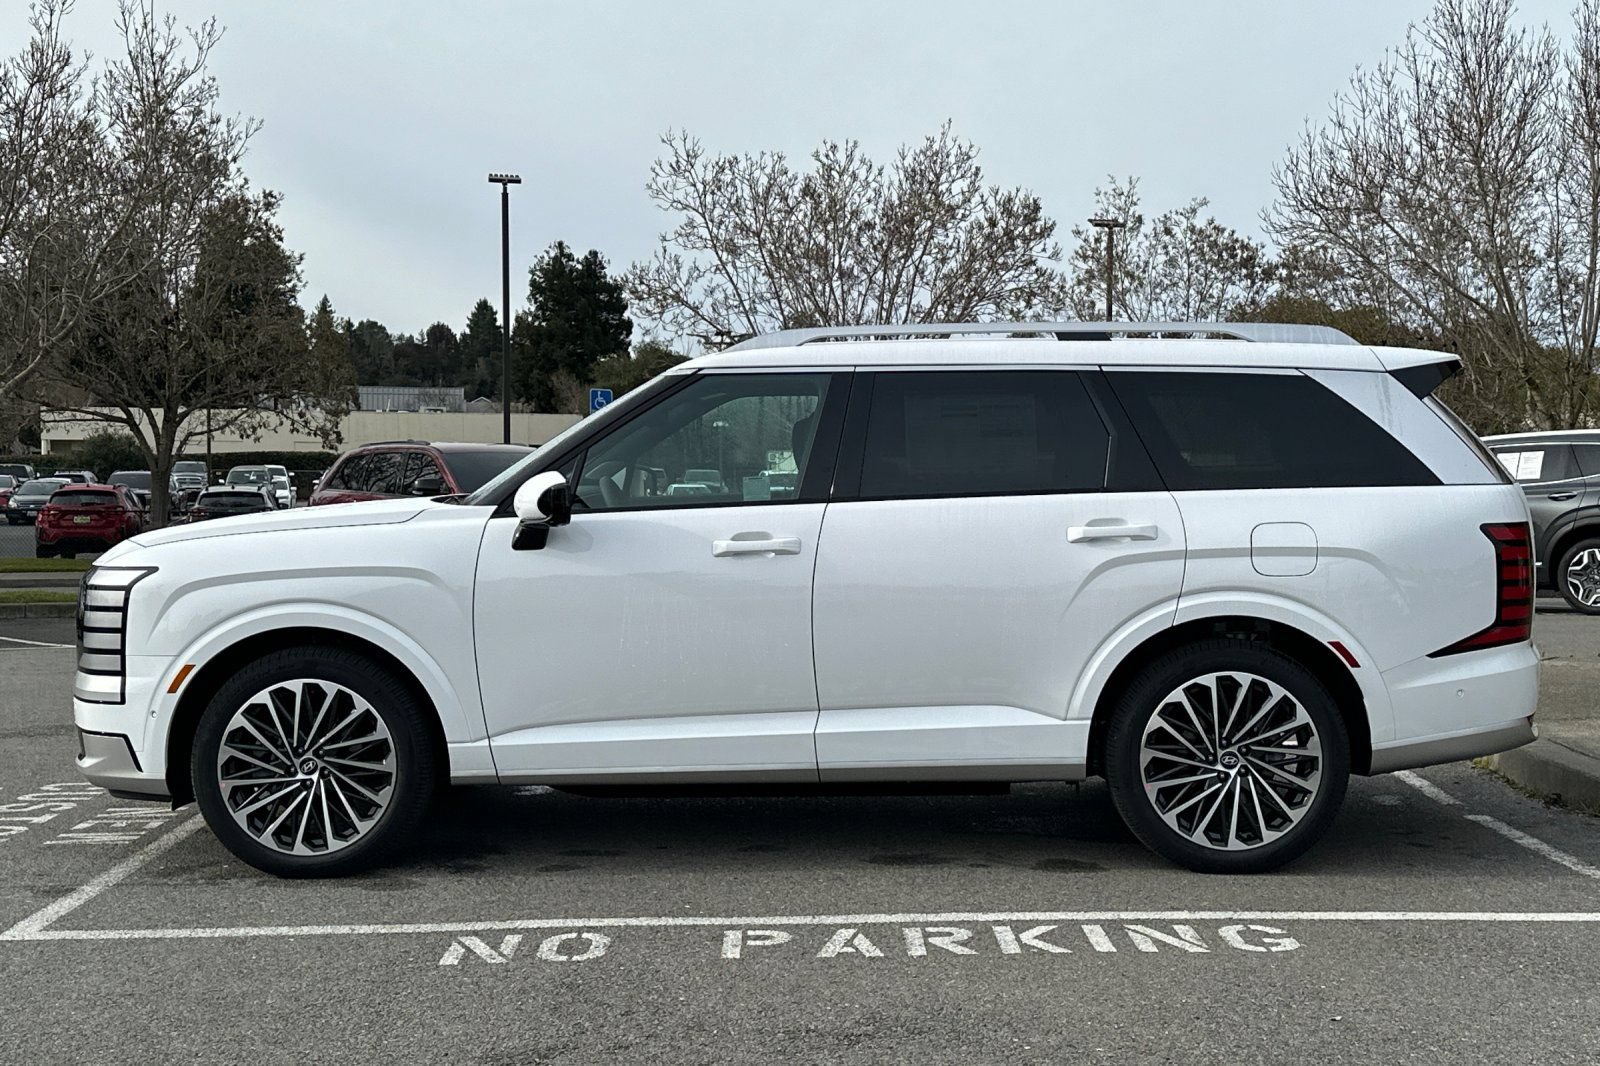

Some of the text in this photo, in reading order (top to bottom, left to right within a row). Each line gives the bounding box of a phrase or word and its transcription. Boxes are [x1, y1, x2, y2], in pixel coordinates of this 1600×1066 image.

[43, 806, 189, 844] NEW
[439, 924, 1301, 966] NO PARKING
